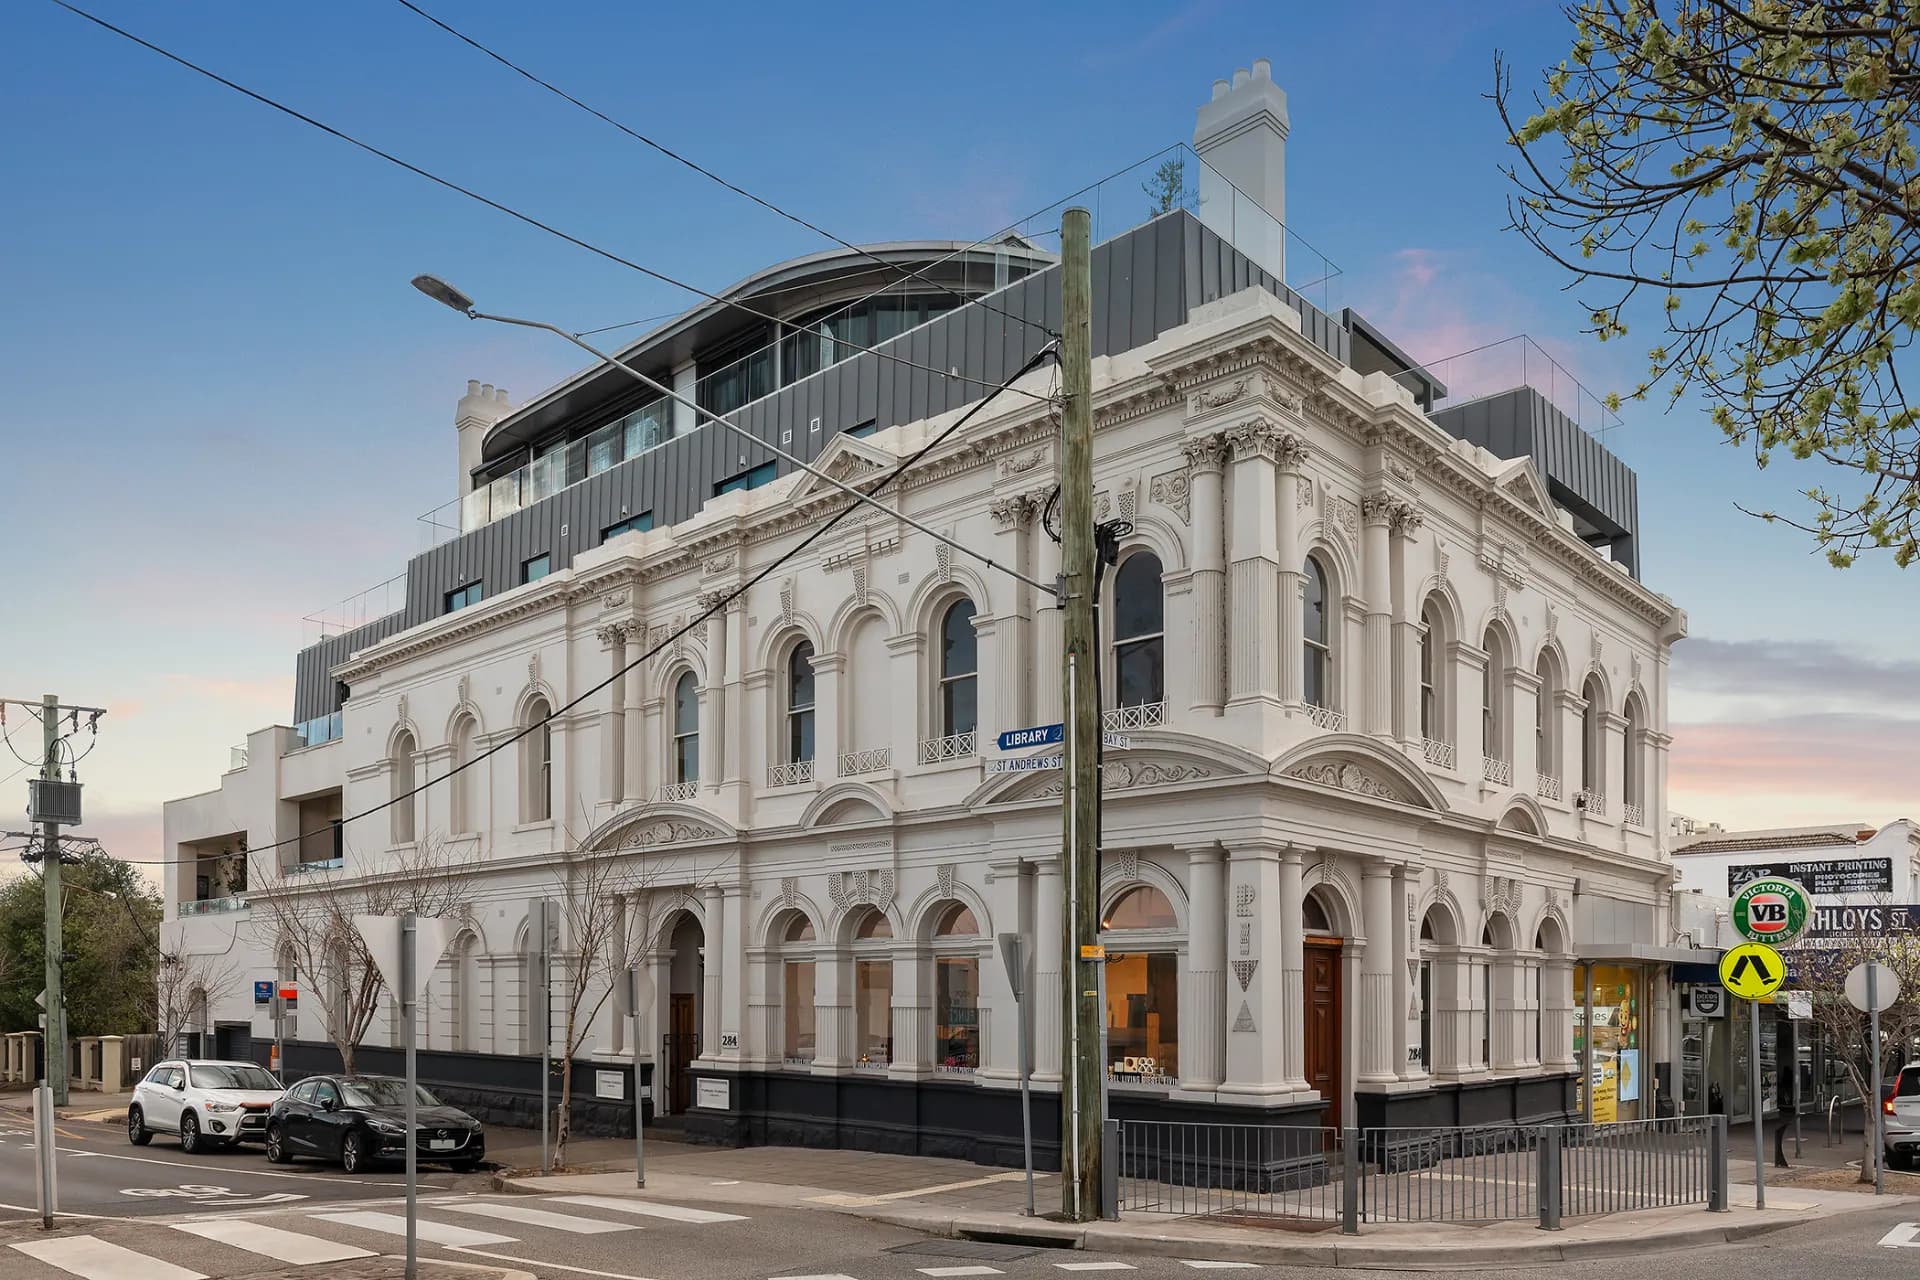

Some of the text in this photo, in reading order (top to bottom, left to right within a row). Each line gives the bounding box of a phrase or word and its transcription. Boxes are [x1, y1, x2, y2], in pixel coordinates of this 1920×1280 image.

[1006, 729, 1048, 746] LIBRARY
[1104, 733, 1129, 748] BAY ST
[997, 756, 1063, 771] ST ANDREWS ST
[1790, 860, 1887, 873] INSTANT PRINTING
[1815, 872, 1880, 880] PHOTOCOPIES
[1815, 877, 1888, 887] PLAN PRINTING
[1742, 883, 1796, 900] VICTORIA
[1750, 904, 1786, 922] VB
[1747, 929, 1793, 942] BITTER
[722, 1035, 738, 1046] 284
[1408, 1048, 1421, 1060] 284
